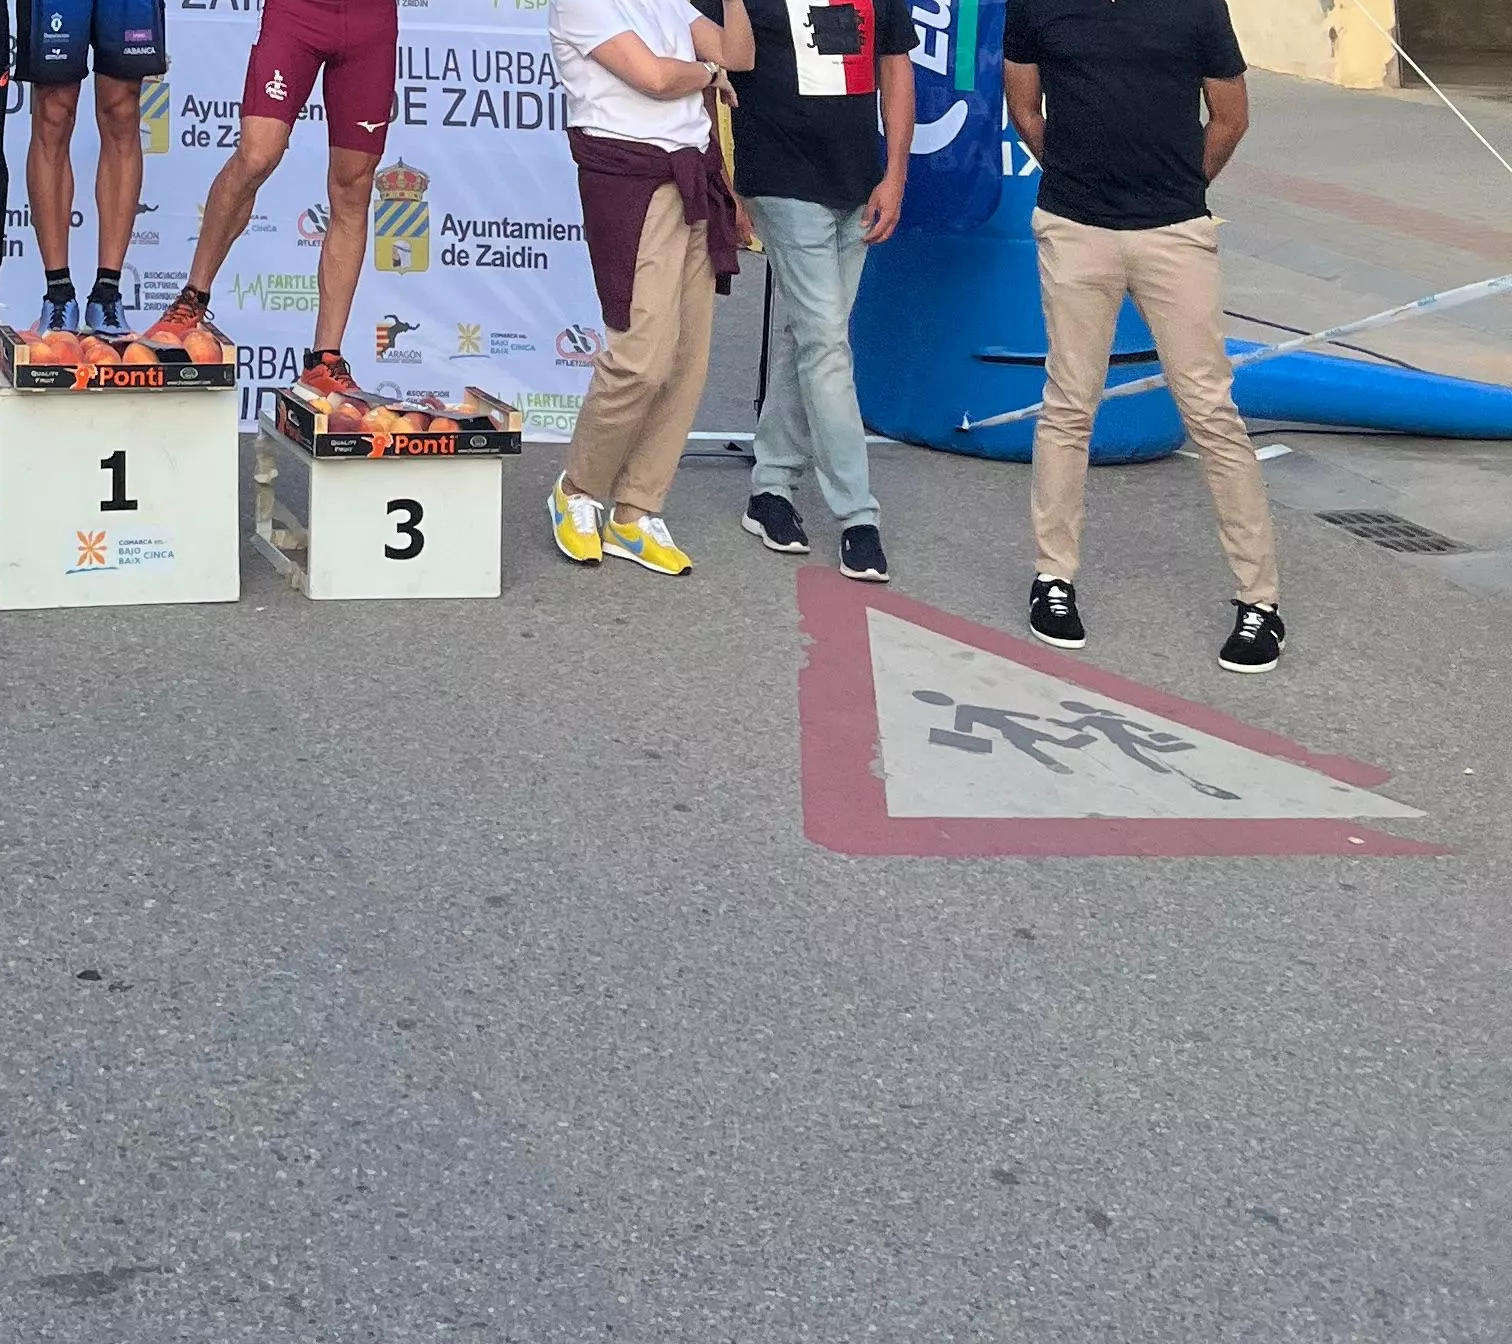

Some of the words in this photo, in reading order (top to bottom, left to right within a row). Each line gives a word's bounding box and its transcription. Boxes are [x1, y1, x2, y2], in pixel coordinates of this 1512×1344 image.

[399, 46, 461, 81] ILLA
[473, 49, 558, 85] URBA
[181, 125, 211, 148] de
[440, 213, 587, 242] Ayuntamien
[441, 243, 470, 266] de
[476, 244, 548, 270] Zaidin
[99, 366, 164, 387] Ponti
[395, 434, 456, 455] Ponti
[100, 450, 138, 512] 1
[384, 498, 425, 560] 3
[118, 547, 142, 556] BAJO
[118, 557, 142, 565] BAIX
[143, 550, 175, 560] CINCA
